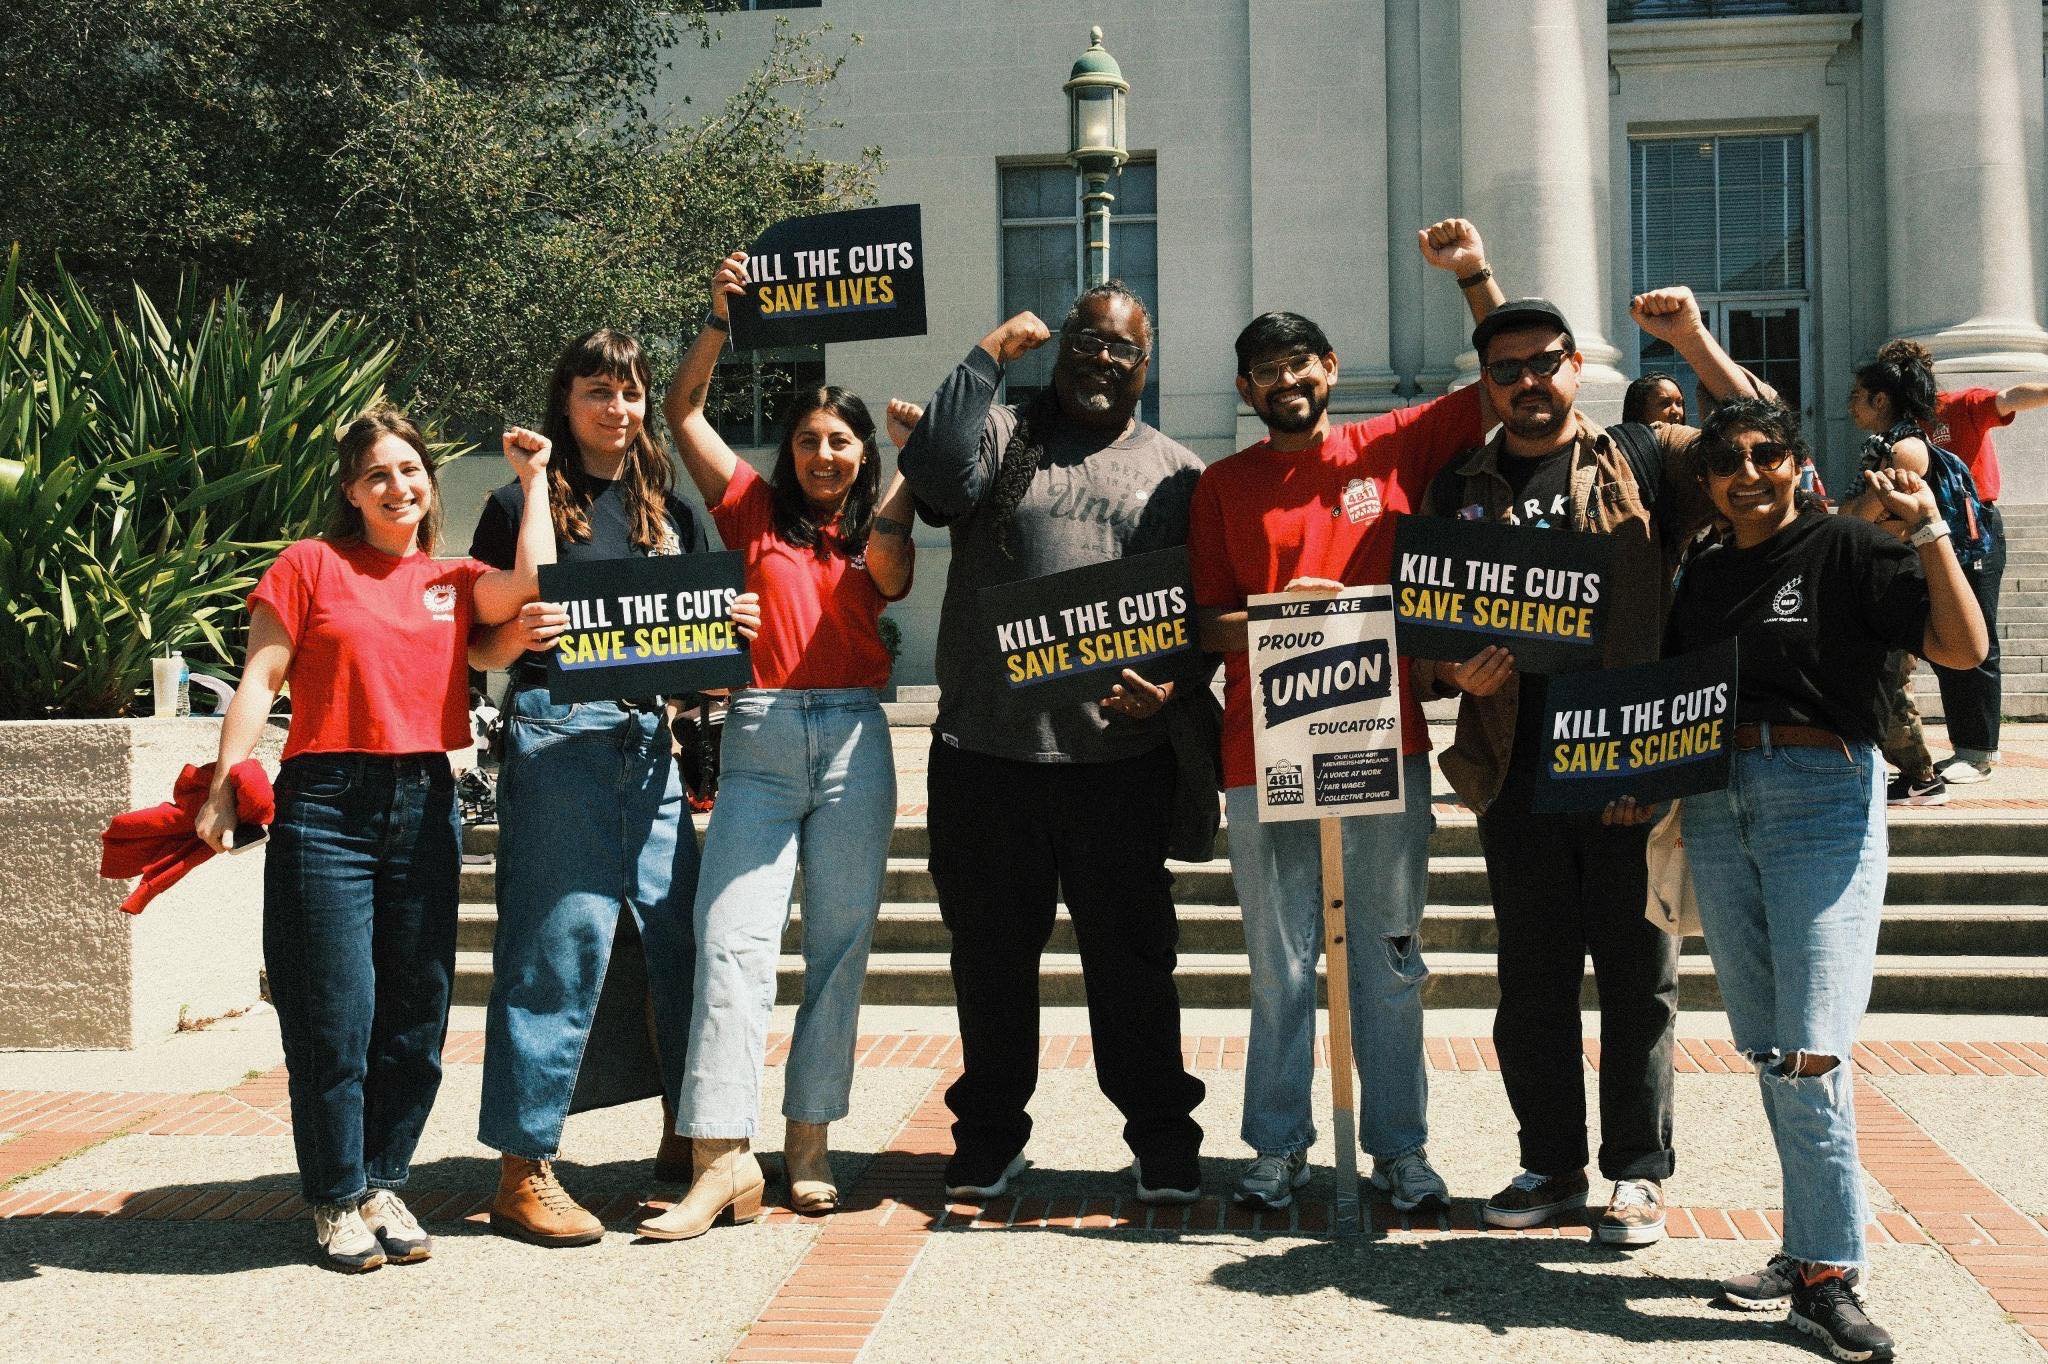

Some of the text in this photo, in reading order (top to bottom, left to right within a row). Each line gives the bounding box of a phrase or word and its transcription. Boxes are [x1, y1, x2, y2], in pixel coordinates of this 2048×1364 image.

[794, 249, 841, 279] THE
[849, 241, 914, 274] CUTS
[758, 275, 895, 314] SAVE LIVES
[1399, 552, 1600, 604] KILL THE CUTS
[618, 593, 669, 626] THE
[676, 587, 737, 621] CUTS
[996, 586, 1187, 653] KILL THE CUTS
[1281, 599, 1362, 617] WE ARE
[1399, 587, 1594, 638] SAVE SCIENCE
[558, 621, 738, 665] SAVE SCIENCE
[1006, 617, 1189, 683] SAVE SCIENCE
[1257, 631, 1325, 652] PROUD
[1271, 653, 1382, 707] UNION
[1308, 717, 1396, 736] EDUCATORS
[1552, 682, 1728, 740] KILL THE CUTS
[1322, 759, 1366, 767] MEMBERSHIP
[1552, 718, 1724, 774] SAVE SCIENCE
[1269, 774, 1299, 785] 4811
[1323, 781, 1366, 791] FAIR WAGES
[1329, 771, 1349, 779] VOICE
[1361, 768, 1382, 777] WORK
[1324, 790, 1390, 802] COLLECTIVE POWER
